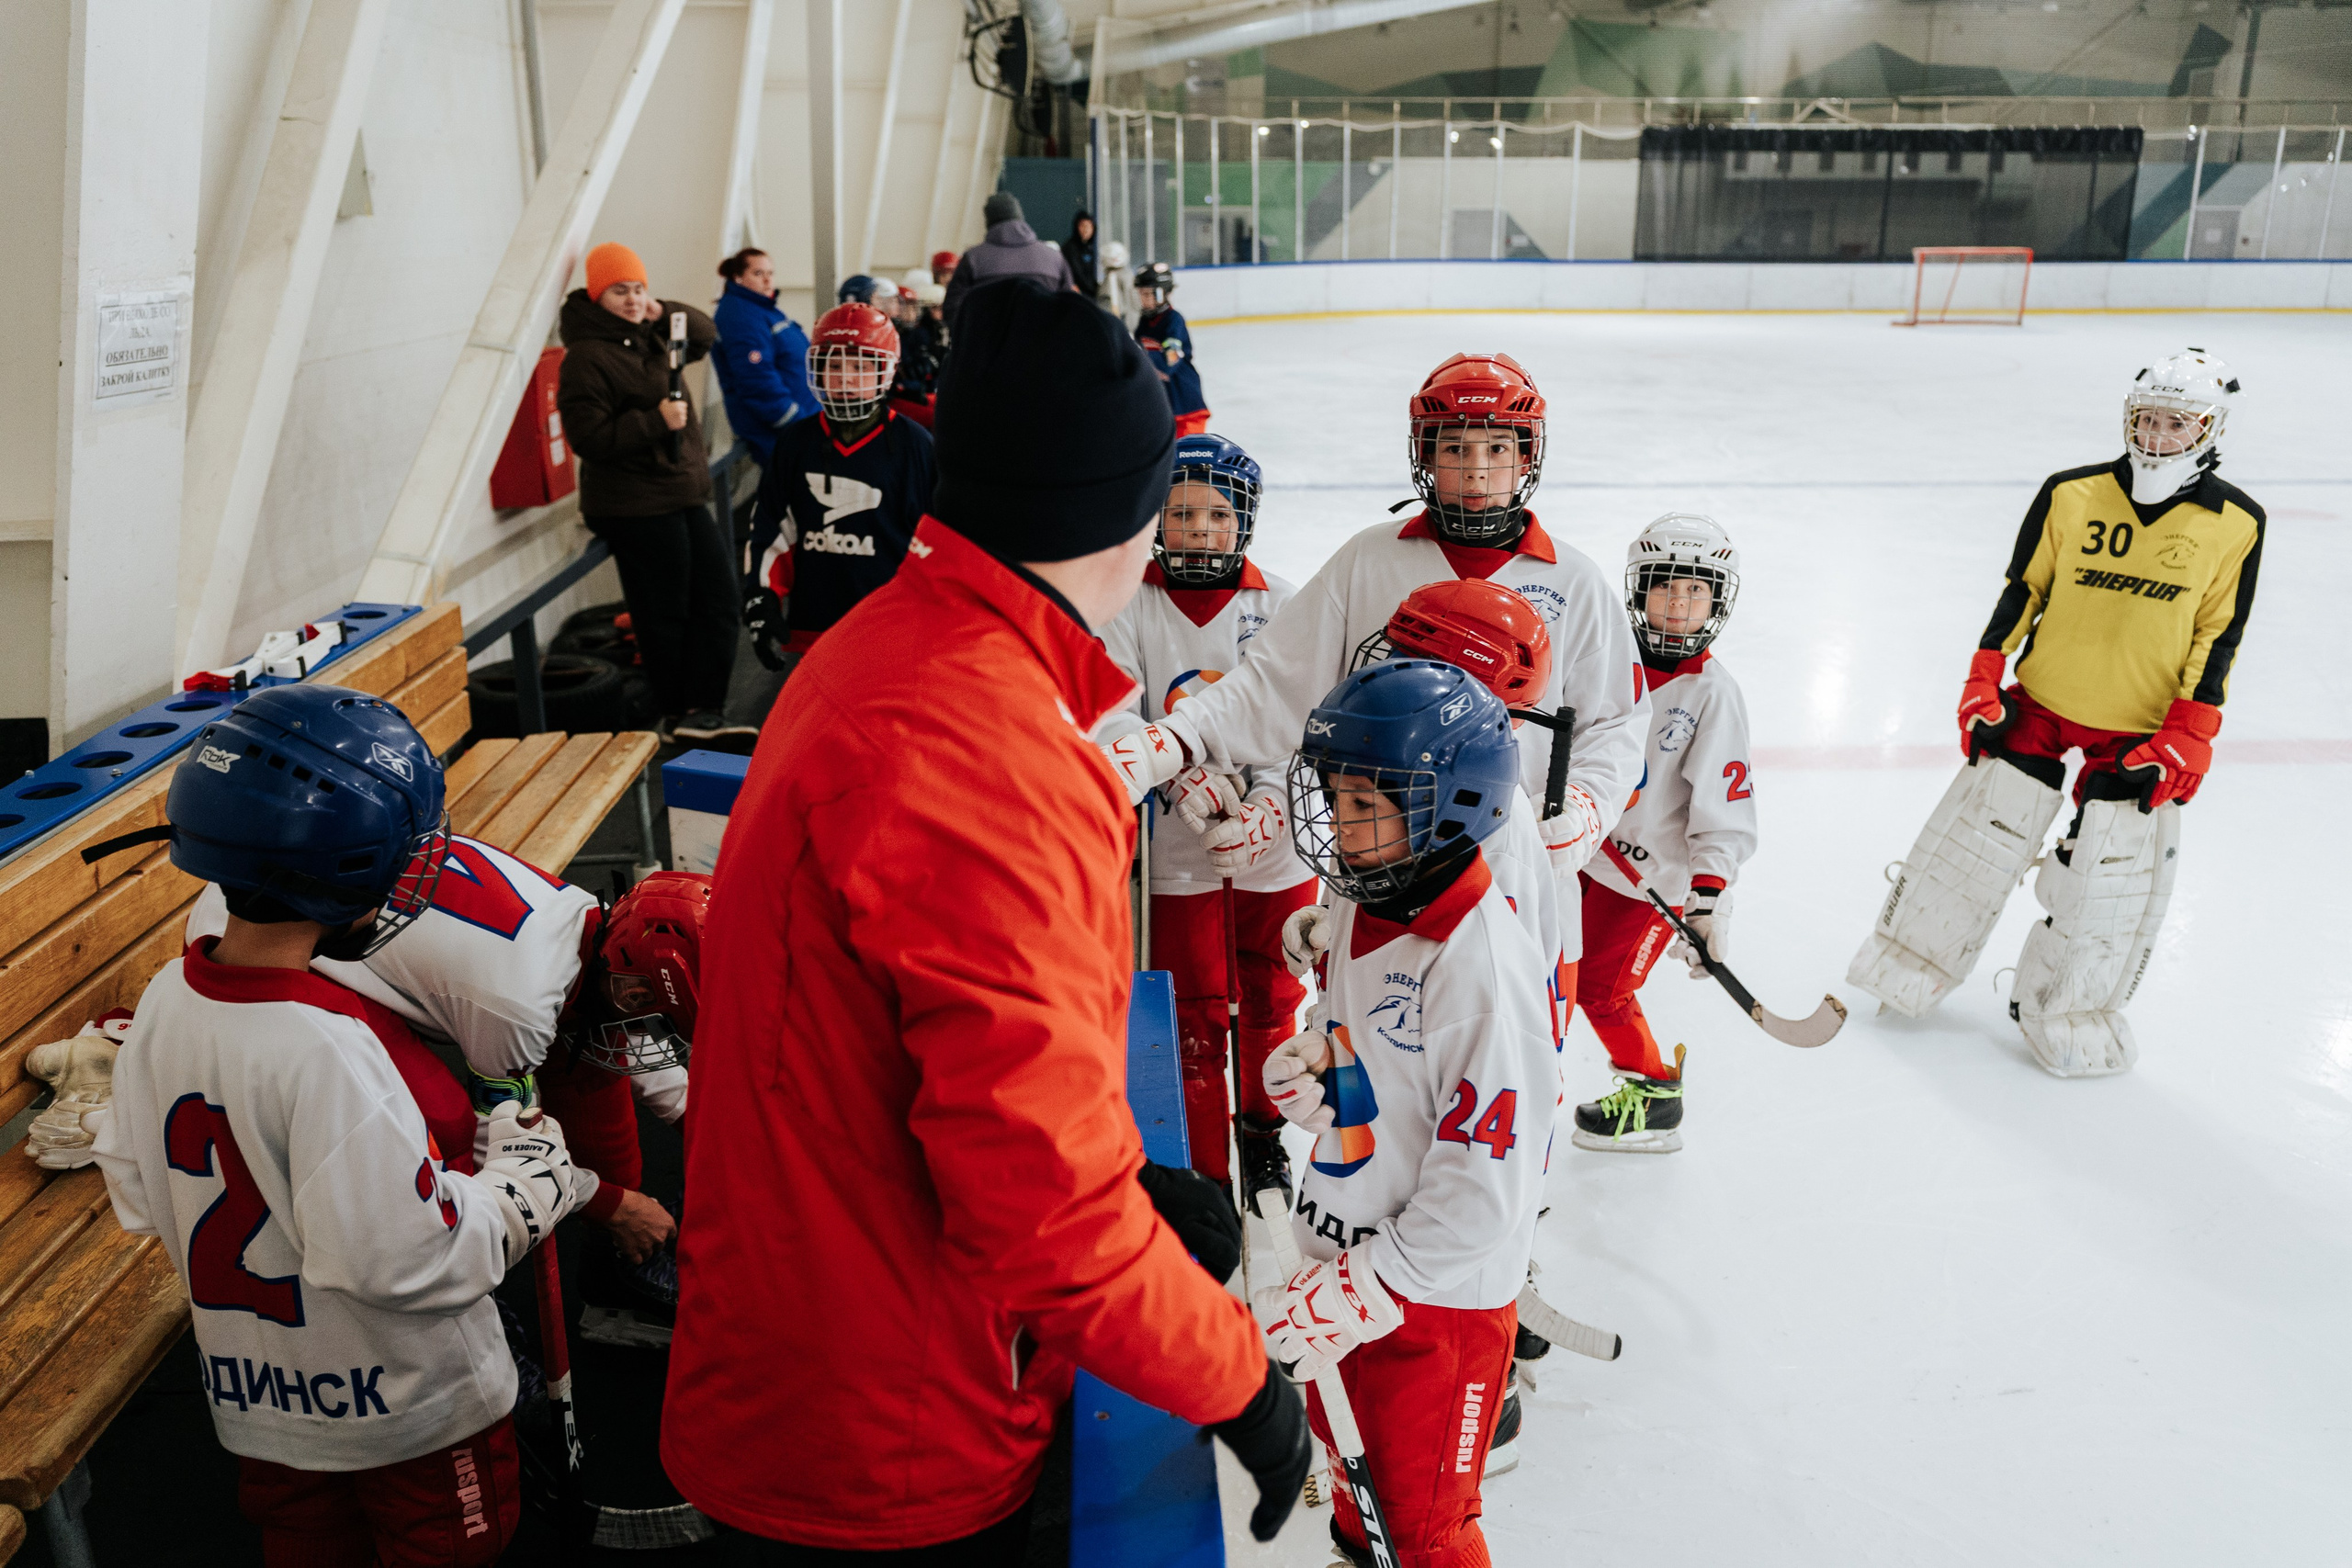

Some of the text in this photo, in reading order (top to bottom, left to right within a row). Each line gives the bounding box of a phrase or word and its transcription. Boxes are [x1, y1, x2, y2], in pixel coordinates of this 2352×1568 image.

[106, 345, 168, 365] ОБЯЗАТЕЛЬНО
[100, 366, 170, 387] ЗАКРОЙ КАЛИТКУ
[2151, 385, 2185, 393] CCM
[1457, 396, 1498, 404] CCM
[1179, 450, 1214, 458] Reebok
[2081, 520, 2133, 558] 30
[1463, 649, 1495, 664] CCM
[1722, 760, 1755, 803] 2
[1630, 924, 1663, 976] rusport
[661, 968, 679, 1005] CCM
[1377, 1026, 1425, 1053] КОДИНСК
[1436, 1077, 1518, 1161] 24
[502, 1144, 544, 1153] RAIDER 90
[164, 1091, 306, 1328] 2
[1338, 1251, 1377, 1324] STEX
[198, 1343, 391, 1419] ДИНСК
[1455, 1382, 1487, 1474] rusport
[451, 1447, 489, 1539] rusport
